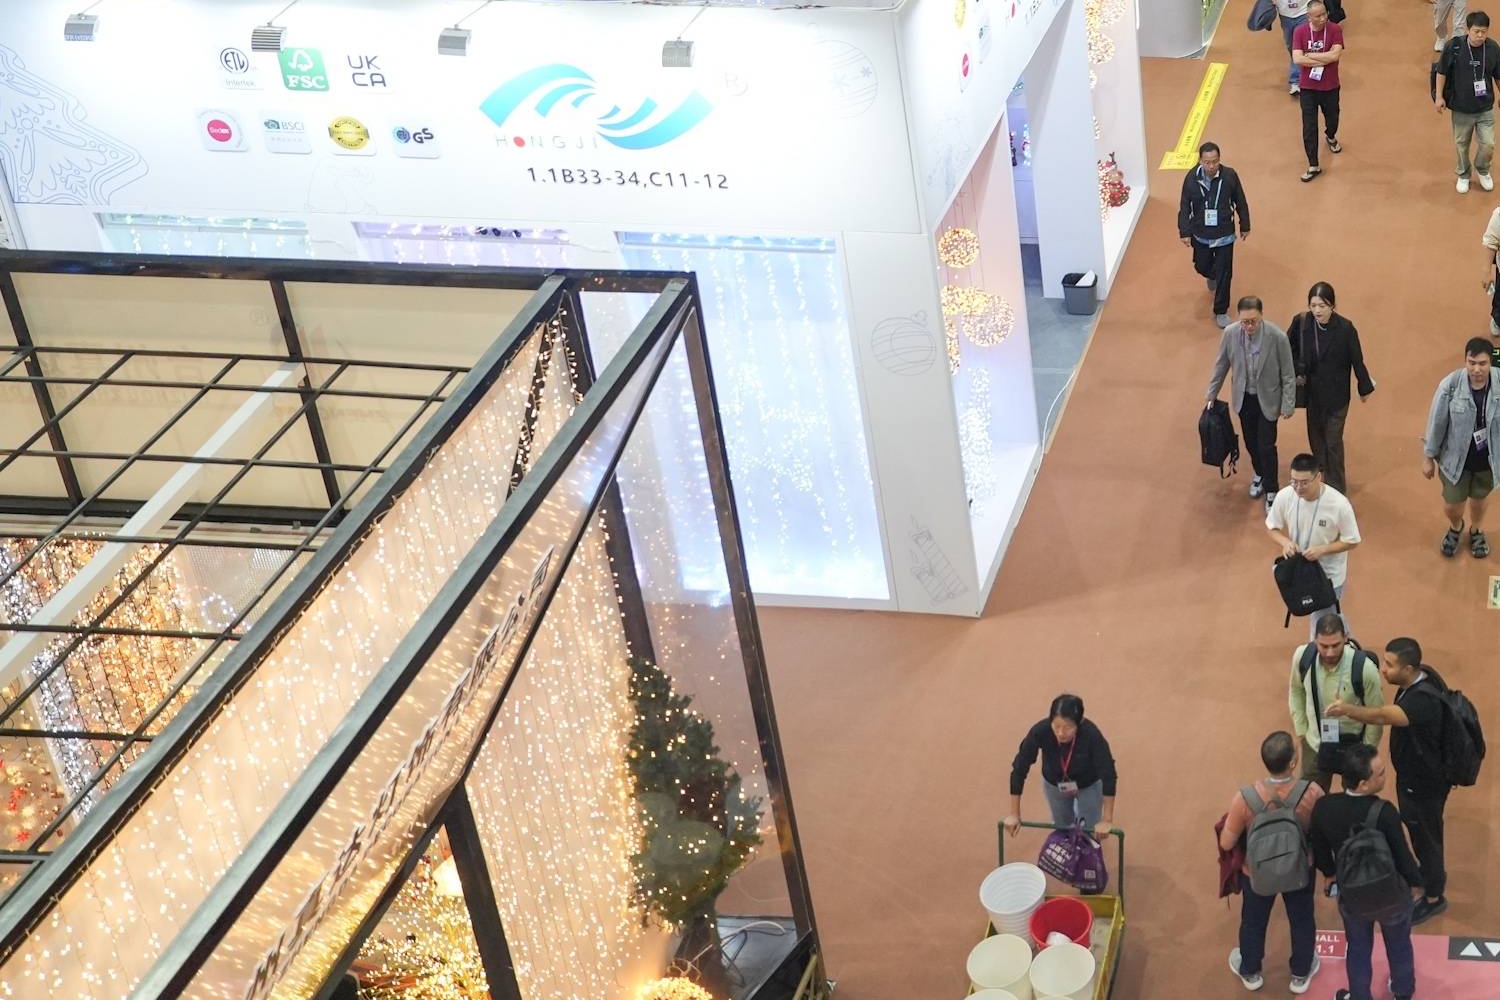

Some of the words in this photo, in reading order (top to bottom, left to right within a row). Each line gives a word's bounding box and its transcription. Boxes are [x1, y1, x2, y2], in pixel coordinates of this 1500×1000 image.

[347, 54, 382, 70] UK
[287, 74, 327, 89] FSC
[352, 72, 387, 88] CA
[412, 127, 434, 144] GS
[527, 166, 729, 189] 1.1B33-34,C11-12
[1316, 944, 1335, 953] 1.1
